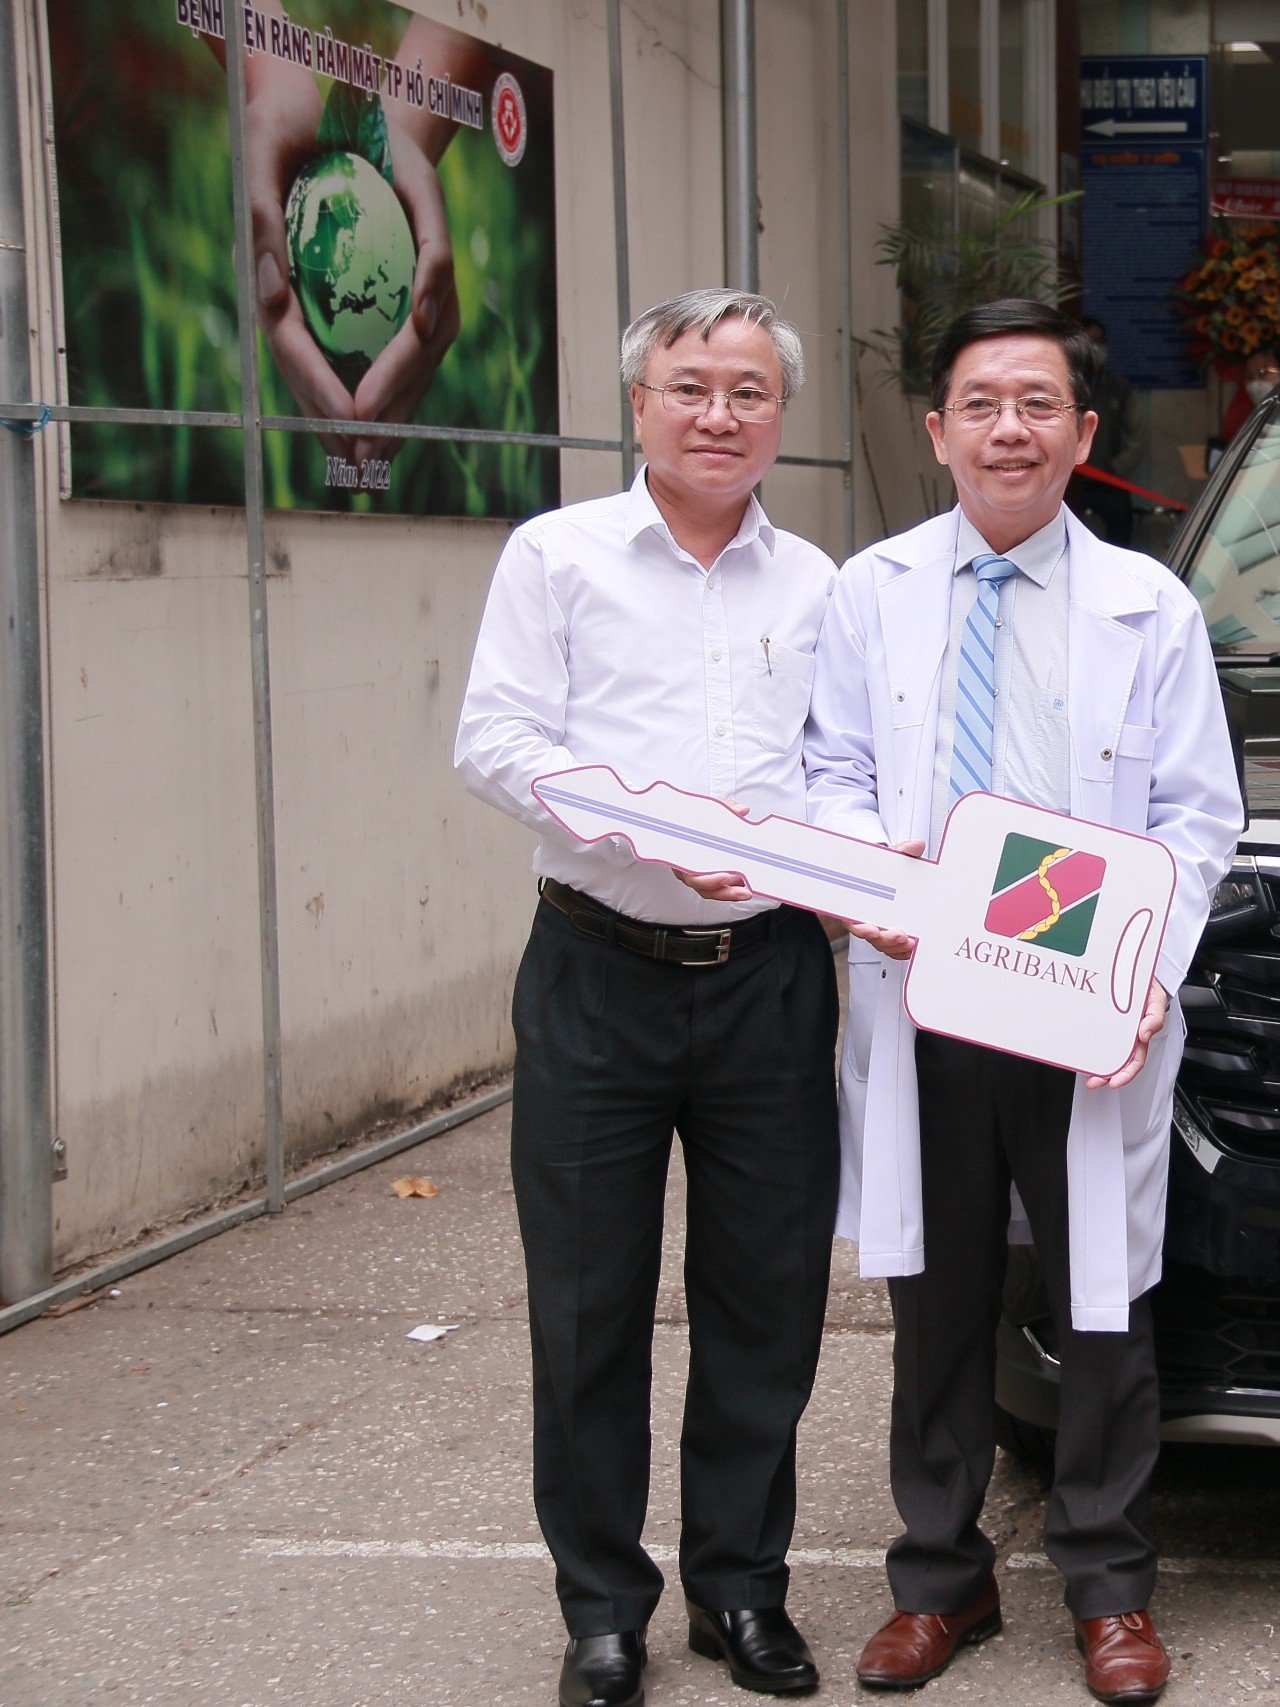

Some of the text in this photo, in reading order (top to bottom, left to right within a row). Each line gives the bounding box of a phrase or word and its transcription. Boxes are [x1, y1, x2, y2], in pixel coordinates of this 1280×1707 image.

[243, 0, 266, 57] ỆN
[270, 11, 313, 70] RĂNG
[314, 26, 350, 84] HÀM
[352, 42, 382, 101] MẶT
[385, 60, 402, 99] TP
[428, 71, 450, 116] CHÍ
[451, 83, 483, 129] MINH
[325, 456, 391, 490] Năm 2022
[954, 937, 1099, 995] AGRIBANK
